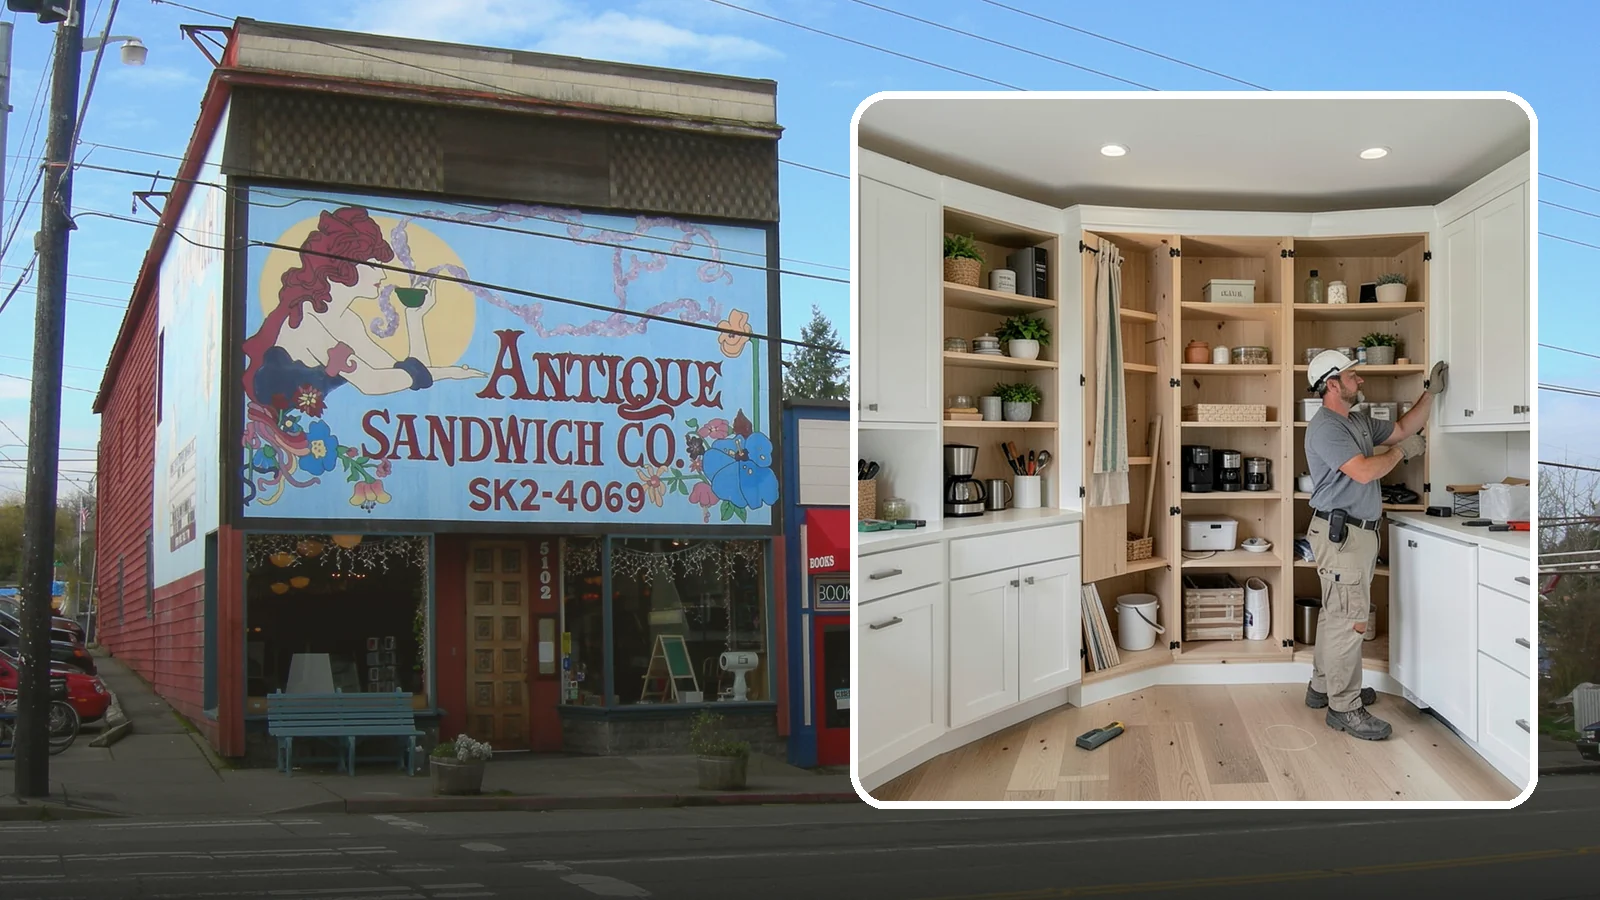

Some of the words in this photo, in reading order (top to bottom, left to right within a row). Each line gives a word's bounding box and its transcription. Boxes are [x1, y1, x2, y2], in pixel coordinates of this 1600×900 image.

[475, 329, 723, 421] ANTIQUE
[361, 409, 604, 467] SANDWICH
[617, 422, 685, 469] CO.
[468, 477, 645, 513] SK2-4069
[539, 541, 551, 599] 5102
[809, 555, 835, 569] BOOKS
